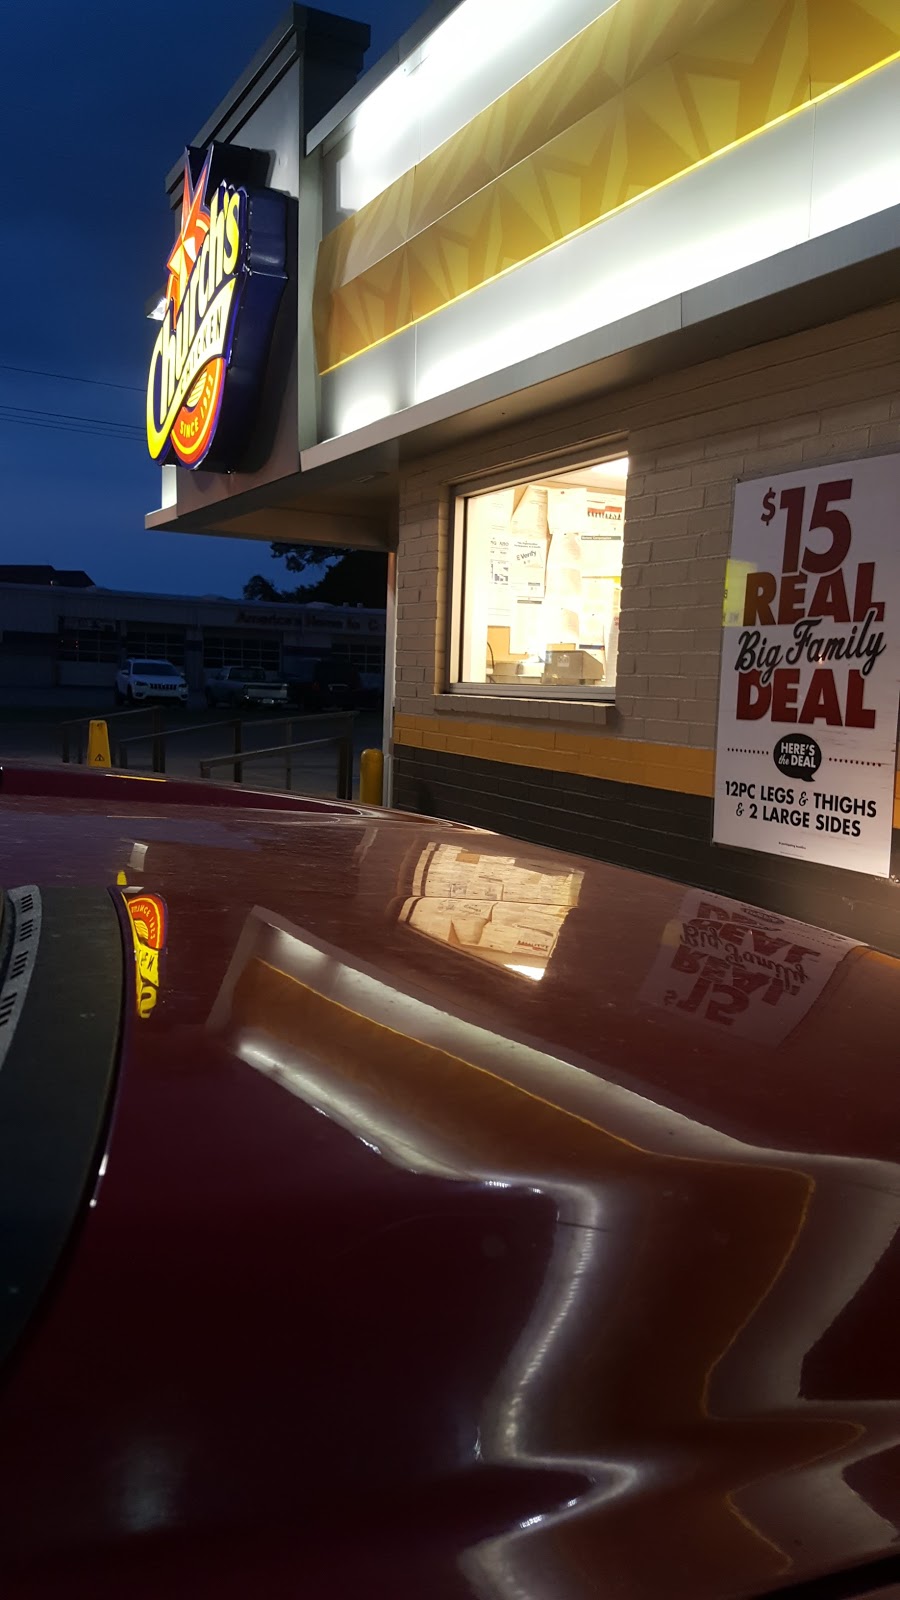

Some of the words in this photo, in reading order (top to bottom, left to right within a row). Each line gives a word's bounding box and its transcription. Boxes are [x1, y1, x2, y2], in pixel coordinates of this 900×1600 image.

[147, 187, 241, 459] Church's
[180, 305, 223, 395] CHICKEN
[179, 416, 199, 438] SINCE
[760, 479, 853, 574] $15
[743, 561, 886, 626] REAL
[734, 631, 784, 684] Big
[785, 609, 887, 677] Family
[736, 668, 876, 729] DEAL
[778, 754, 790, 766] the
[790, 755, 816, 769] DEAL
[780, 742, 816, 756] HERE'S
[725, 780, 756, 799] 12PC
[760, 785, 794, 805] LEGS
[798, 791, 808, 807] &
[813, 792, 877, 818] THIGHS
[735, 802, 744, 816] &
[749, 803, 758, 819] 2
[762, 805, 810, 828] LARGE
[815, 814, 861, 838] SIDES
